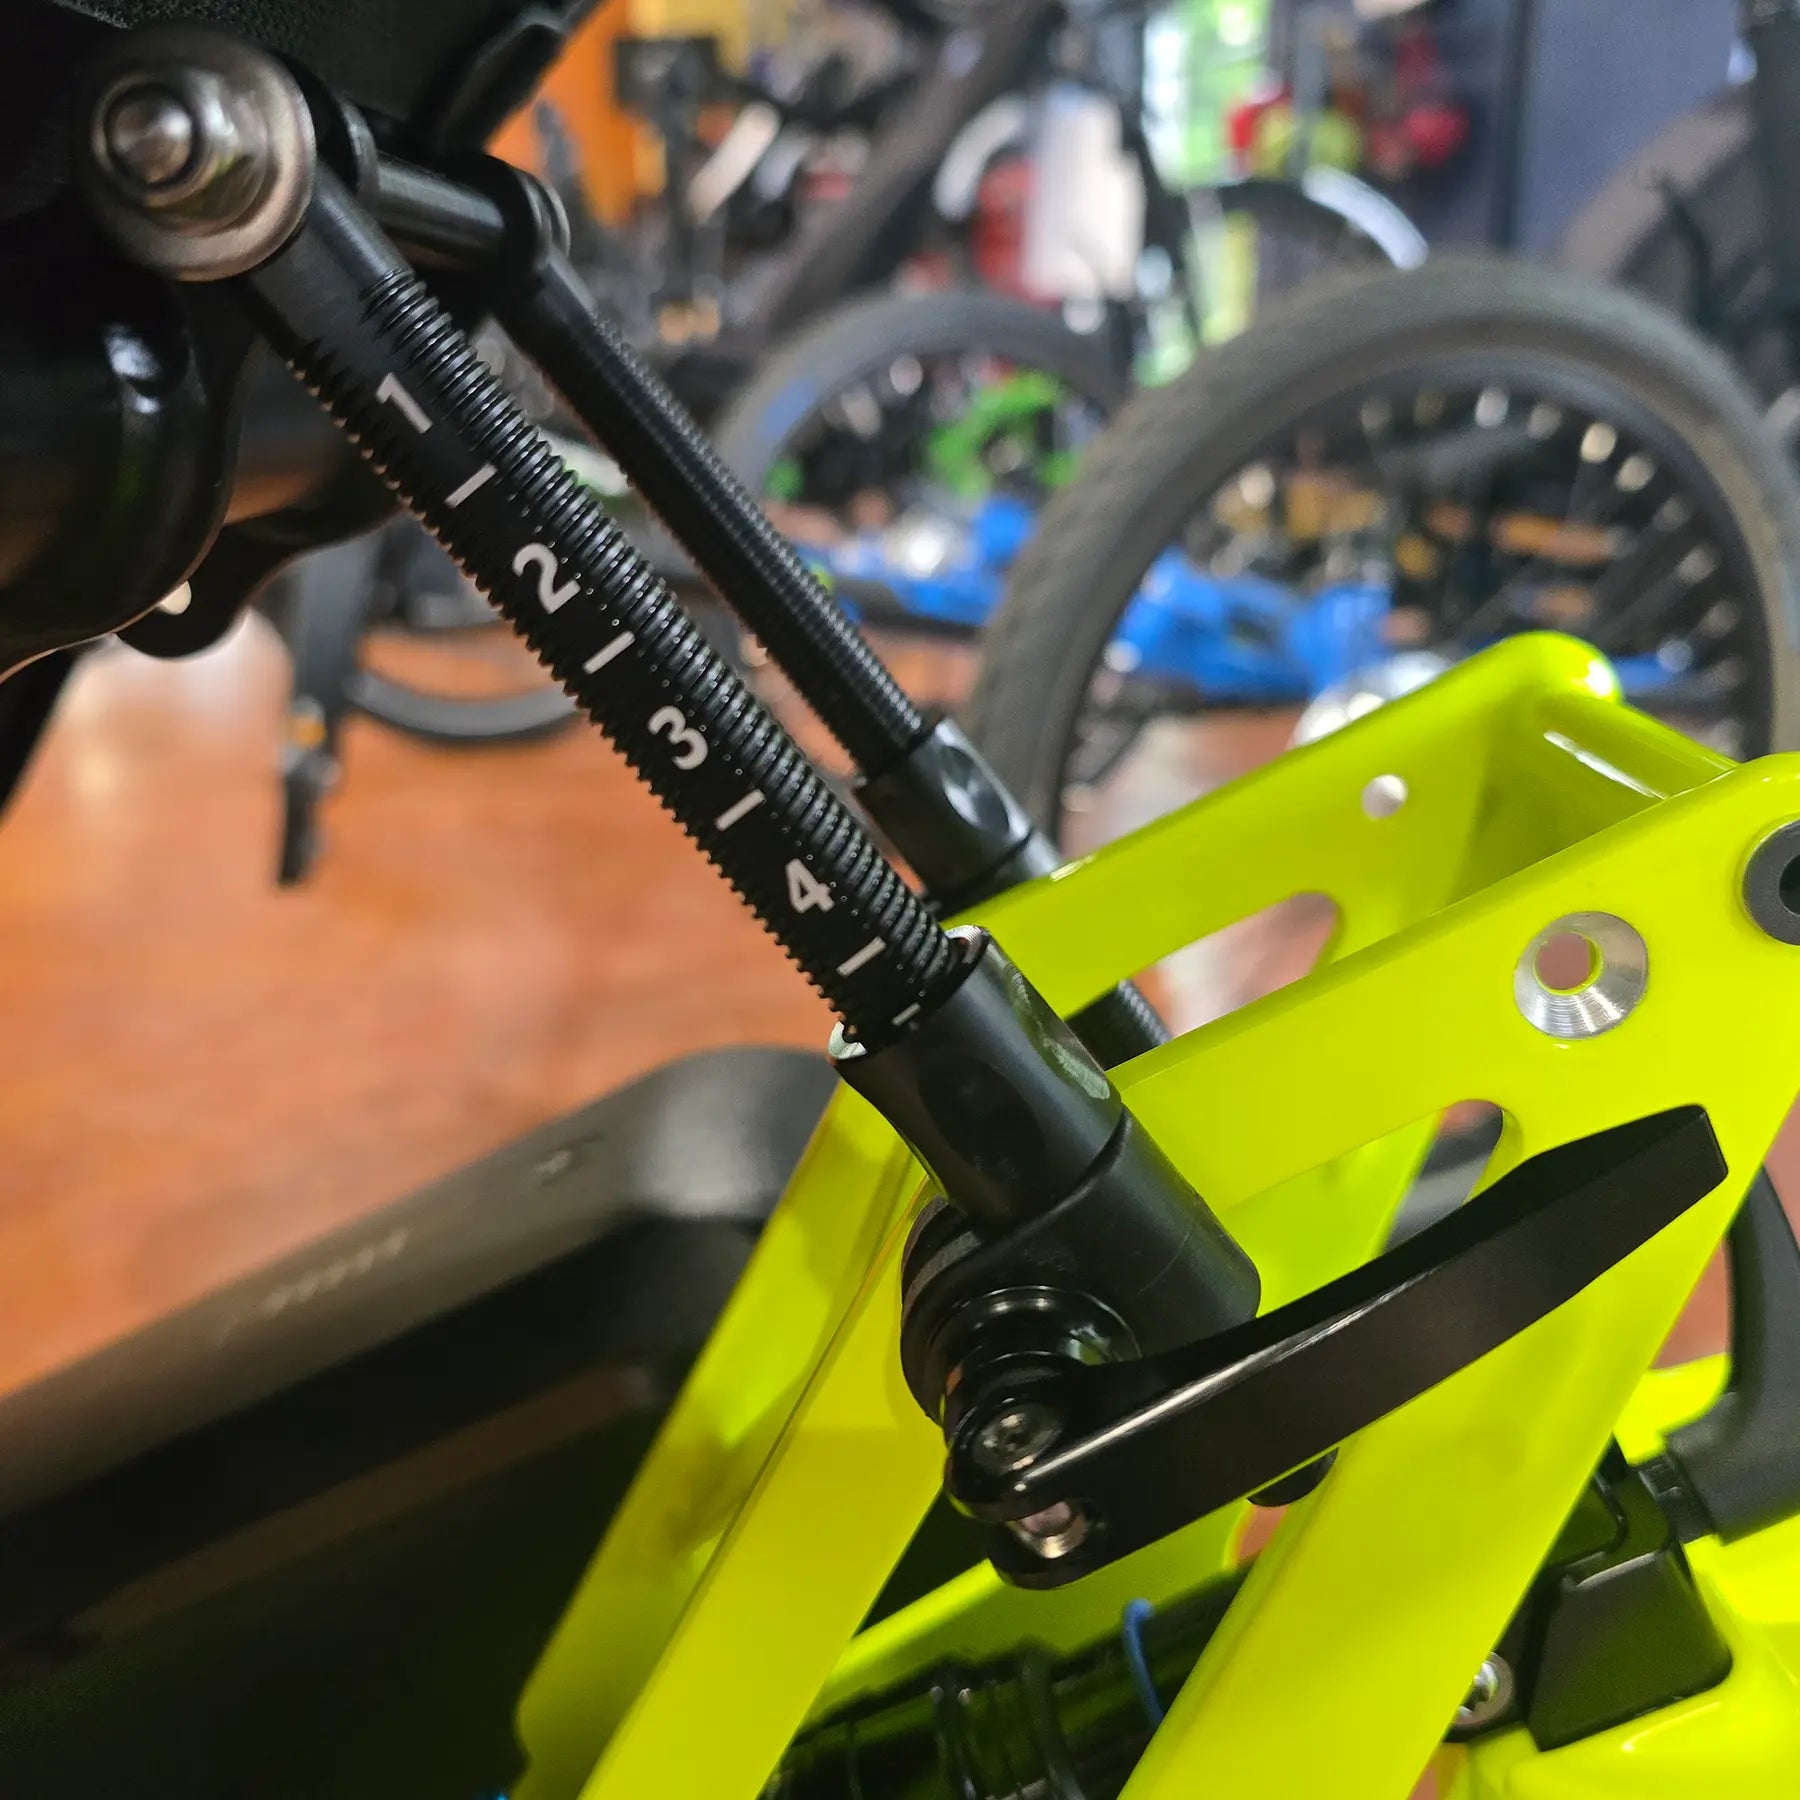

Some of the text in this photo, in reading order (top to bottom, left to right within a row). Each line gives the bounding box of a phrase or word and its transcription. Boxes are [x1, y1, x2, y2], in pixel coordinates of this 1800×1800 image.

[376, 373, 432, 434] 1
[513, 543, 581, 614] 2
[648, 705, 709, 771] 3
[785, 859, 834, 914] 4
